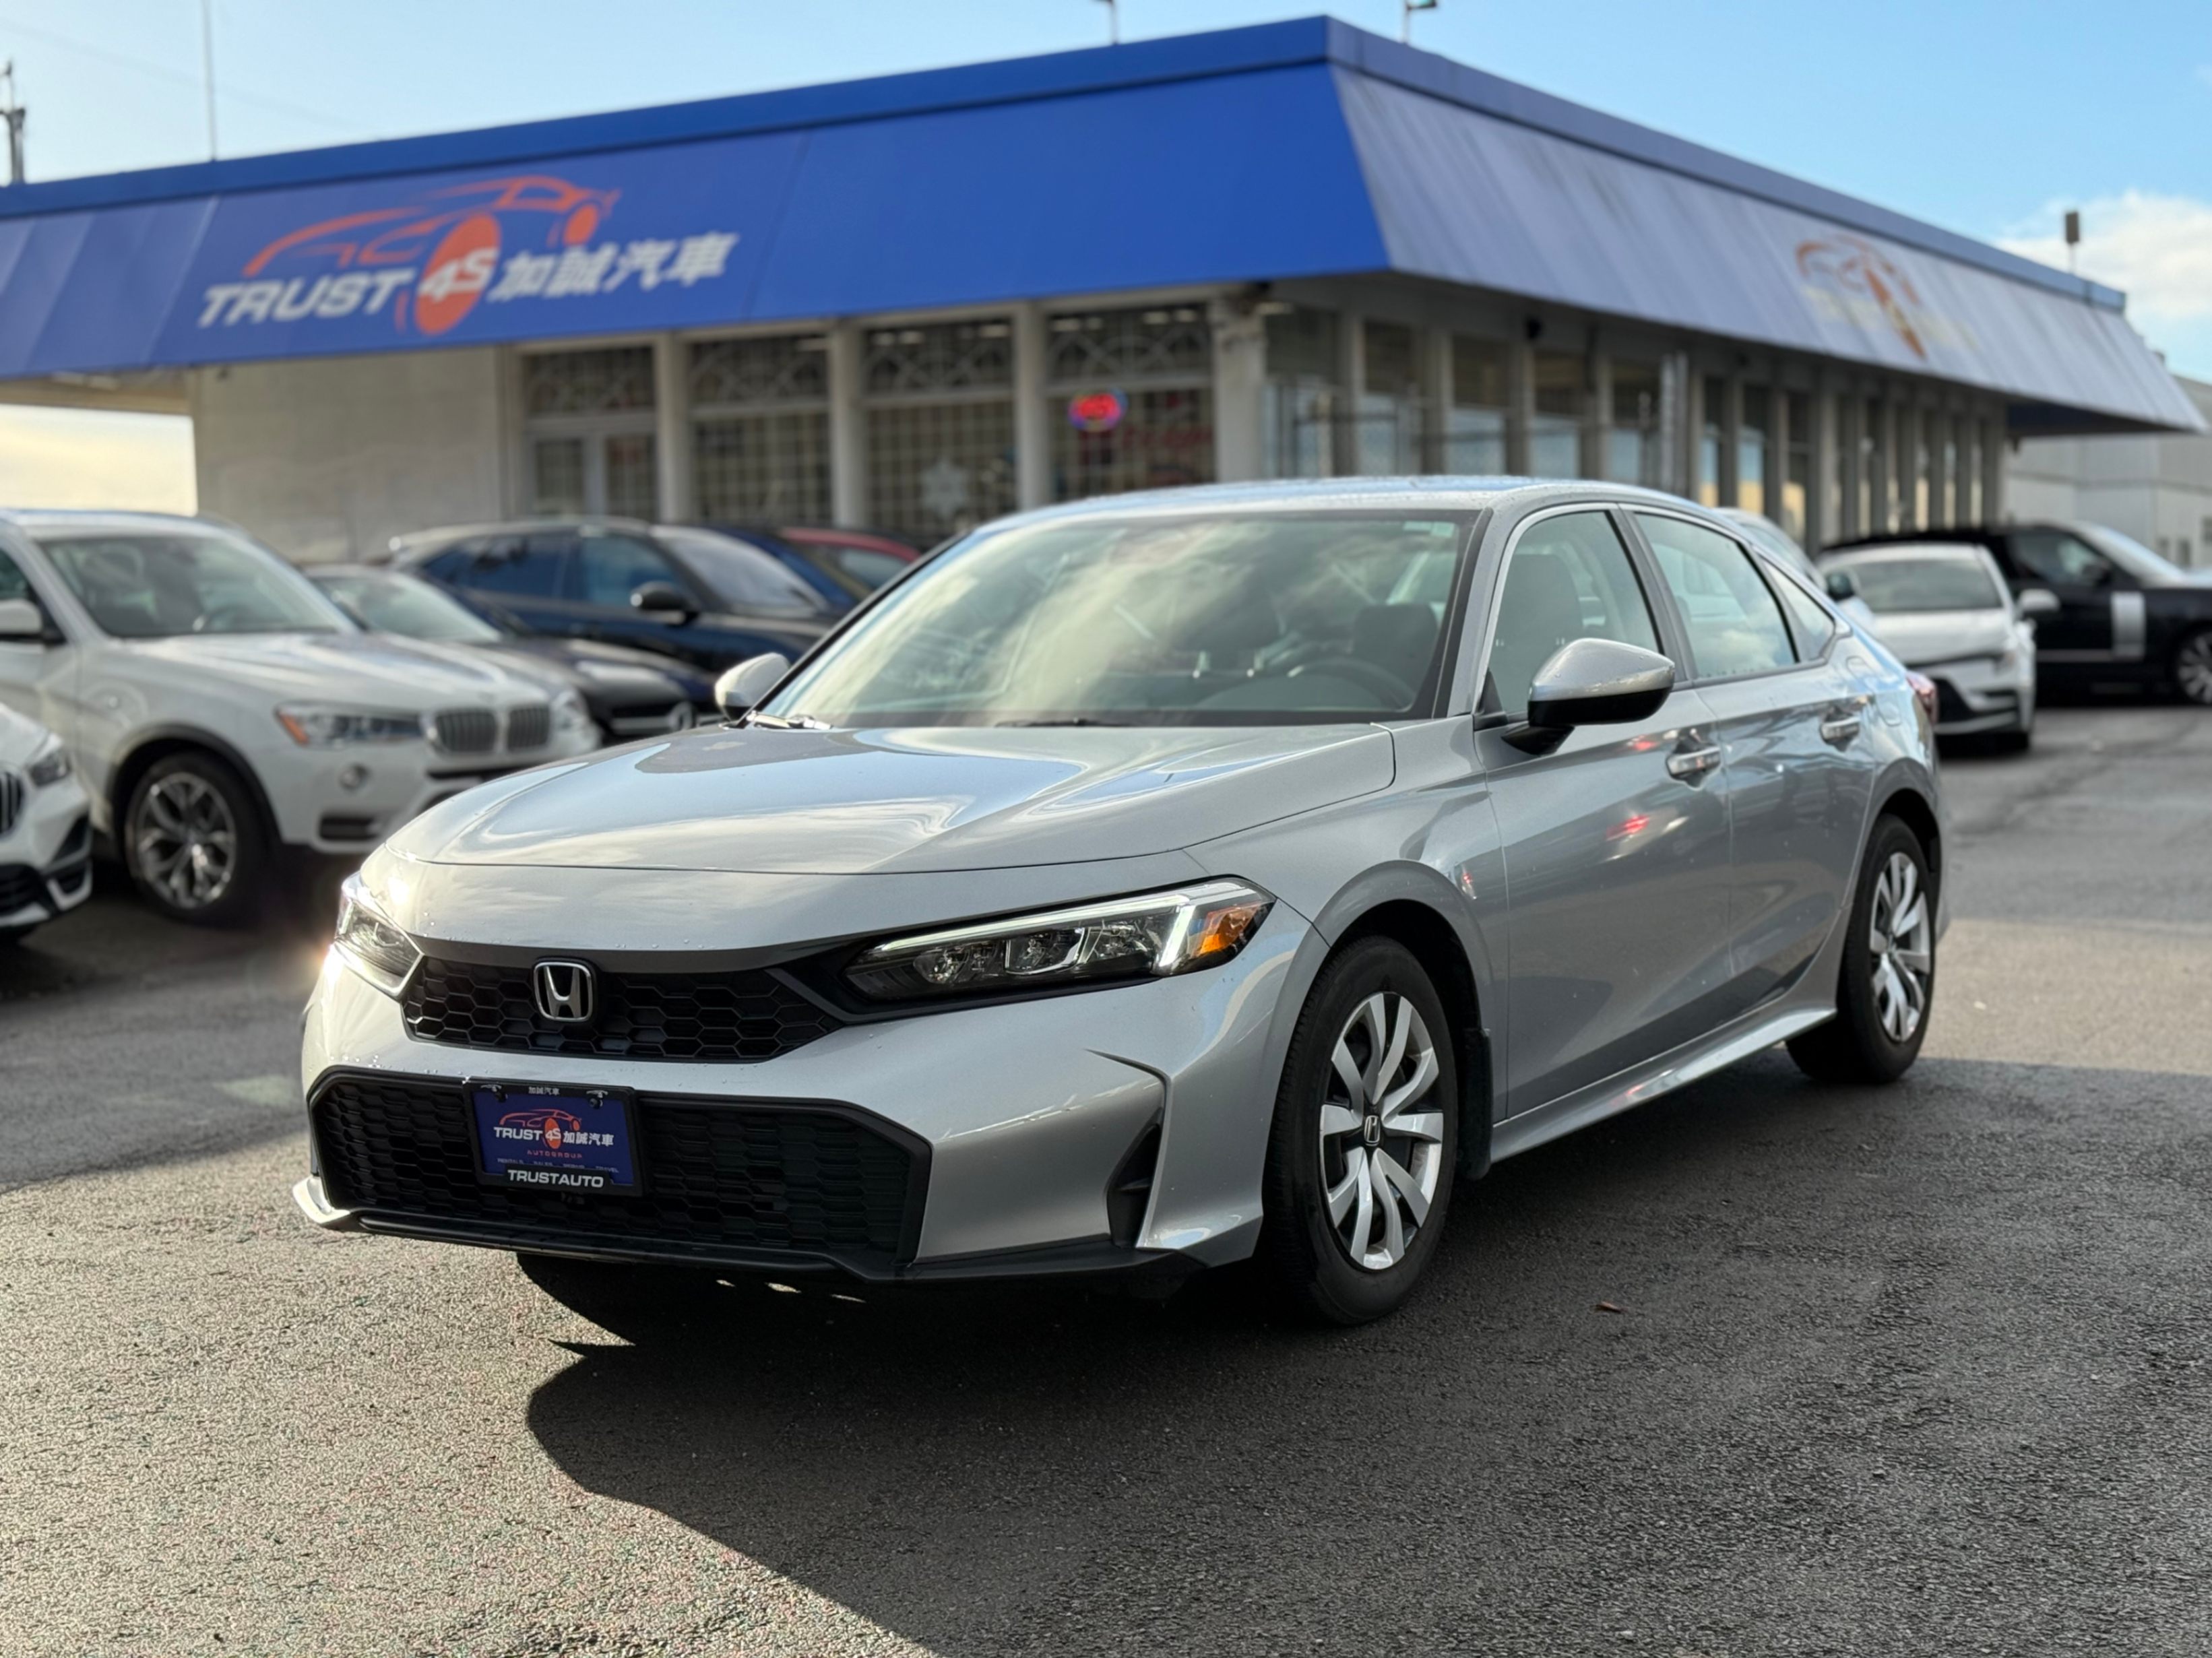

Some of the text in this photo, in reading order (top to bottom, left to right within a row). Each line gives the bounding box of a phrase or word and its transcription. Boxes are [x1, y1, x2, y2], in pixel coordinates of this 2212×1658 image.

[198, 268, 418, 328] TRUST
[494, 1126, 614, 1147] TRUST 4S 加誠汽車
[507, 1170, 604, 1188] TRUSTAUTO
